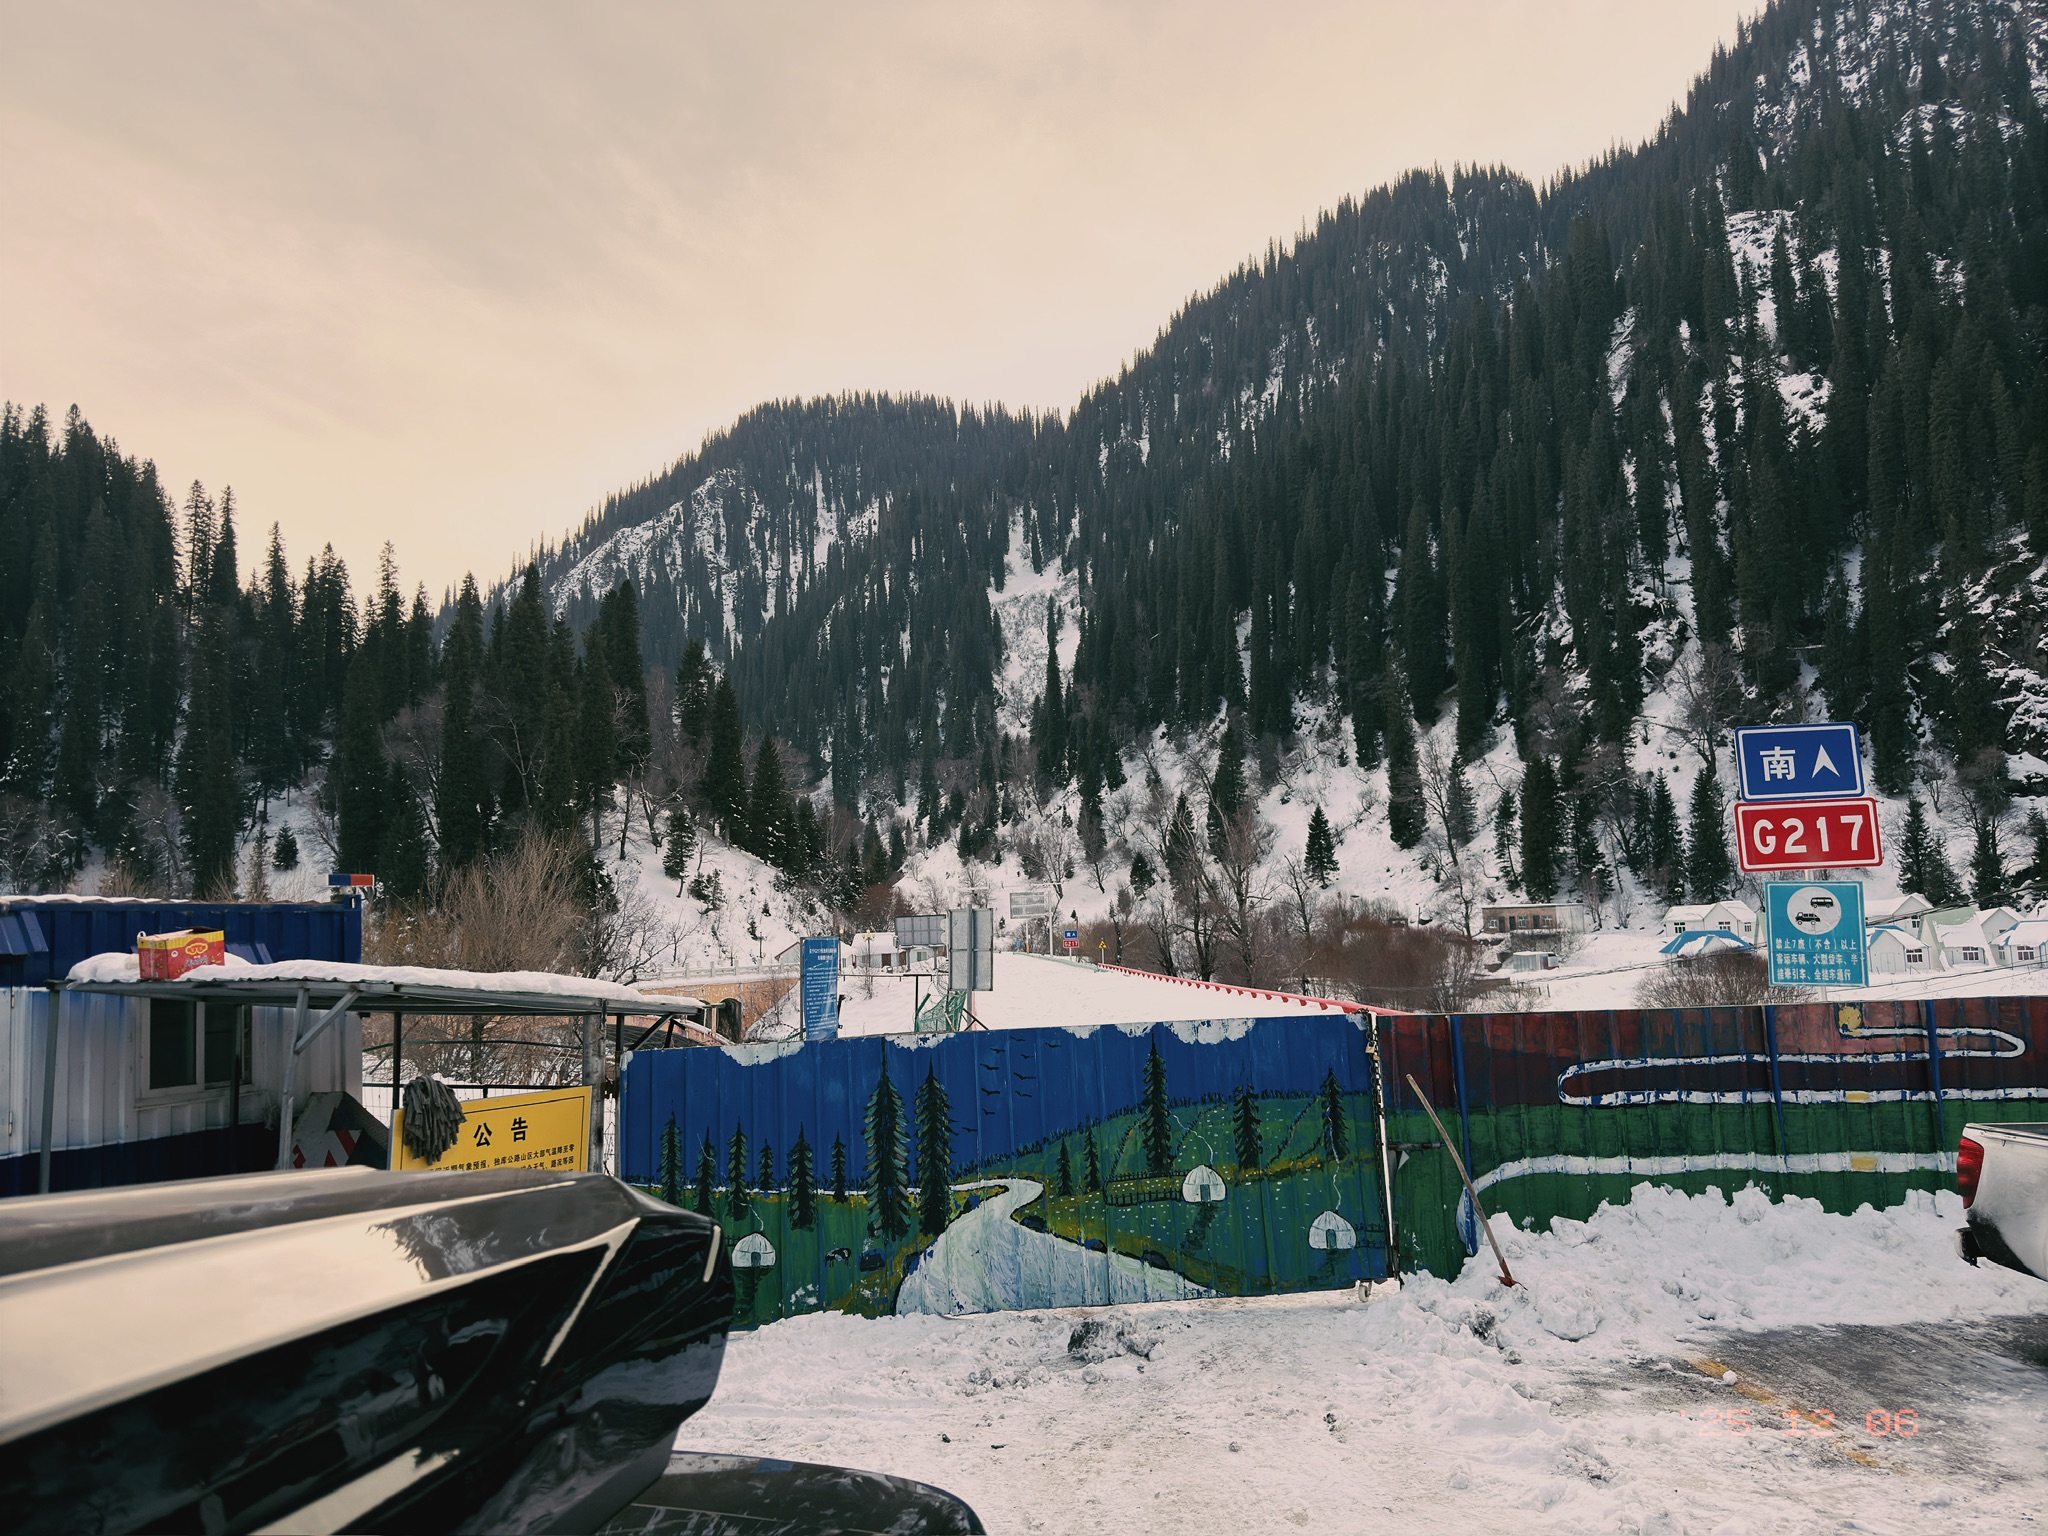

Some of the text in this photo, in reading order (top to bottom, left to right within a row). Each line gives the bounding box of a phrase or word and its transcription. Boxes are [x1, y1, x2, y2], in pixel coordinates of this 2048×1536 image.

[1759, 745, 1796, 782] 南
[1753, 814, 1863, 855] G217
[473, 1116, 528, 1148] 公告
